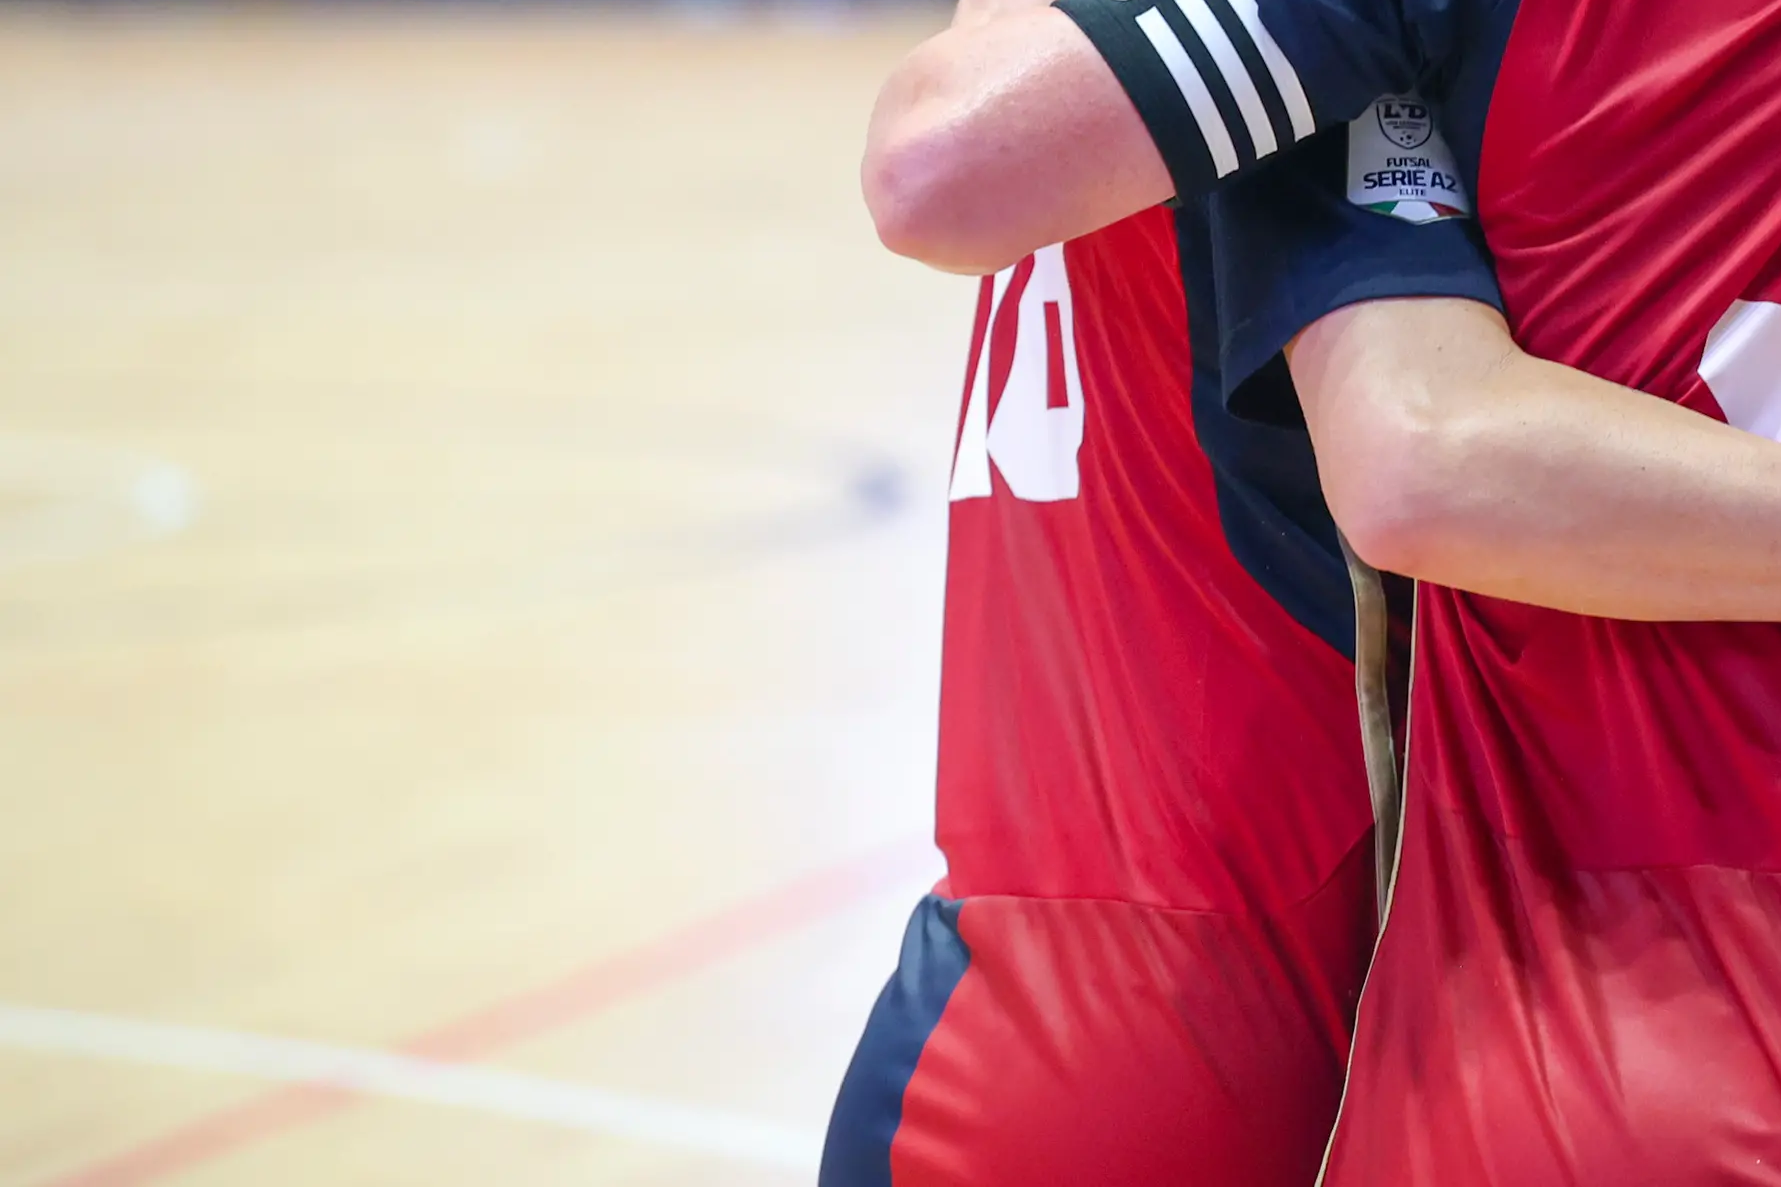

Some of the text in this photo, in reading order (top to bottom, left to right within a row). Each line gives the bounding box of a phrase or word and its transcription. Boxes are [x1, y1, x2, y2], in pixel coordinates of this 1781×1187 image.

[1386, 157, 1432, 168] FUTSAL
[1363, 170, 1457, 193] SERIE A2
